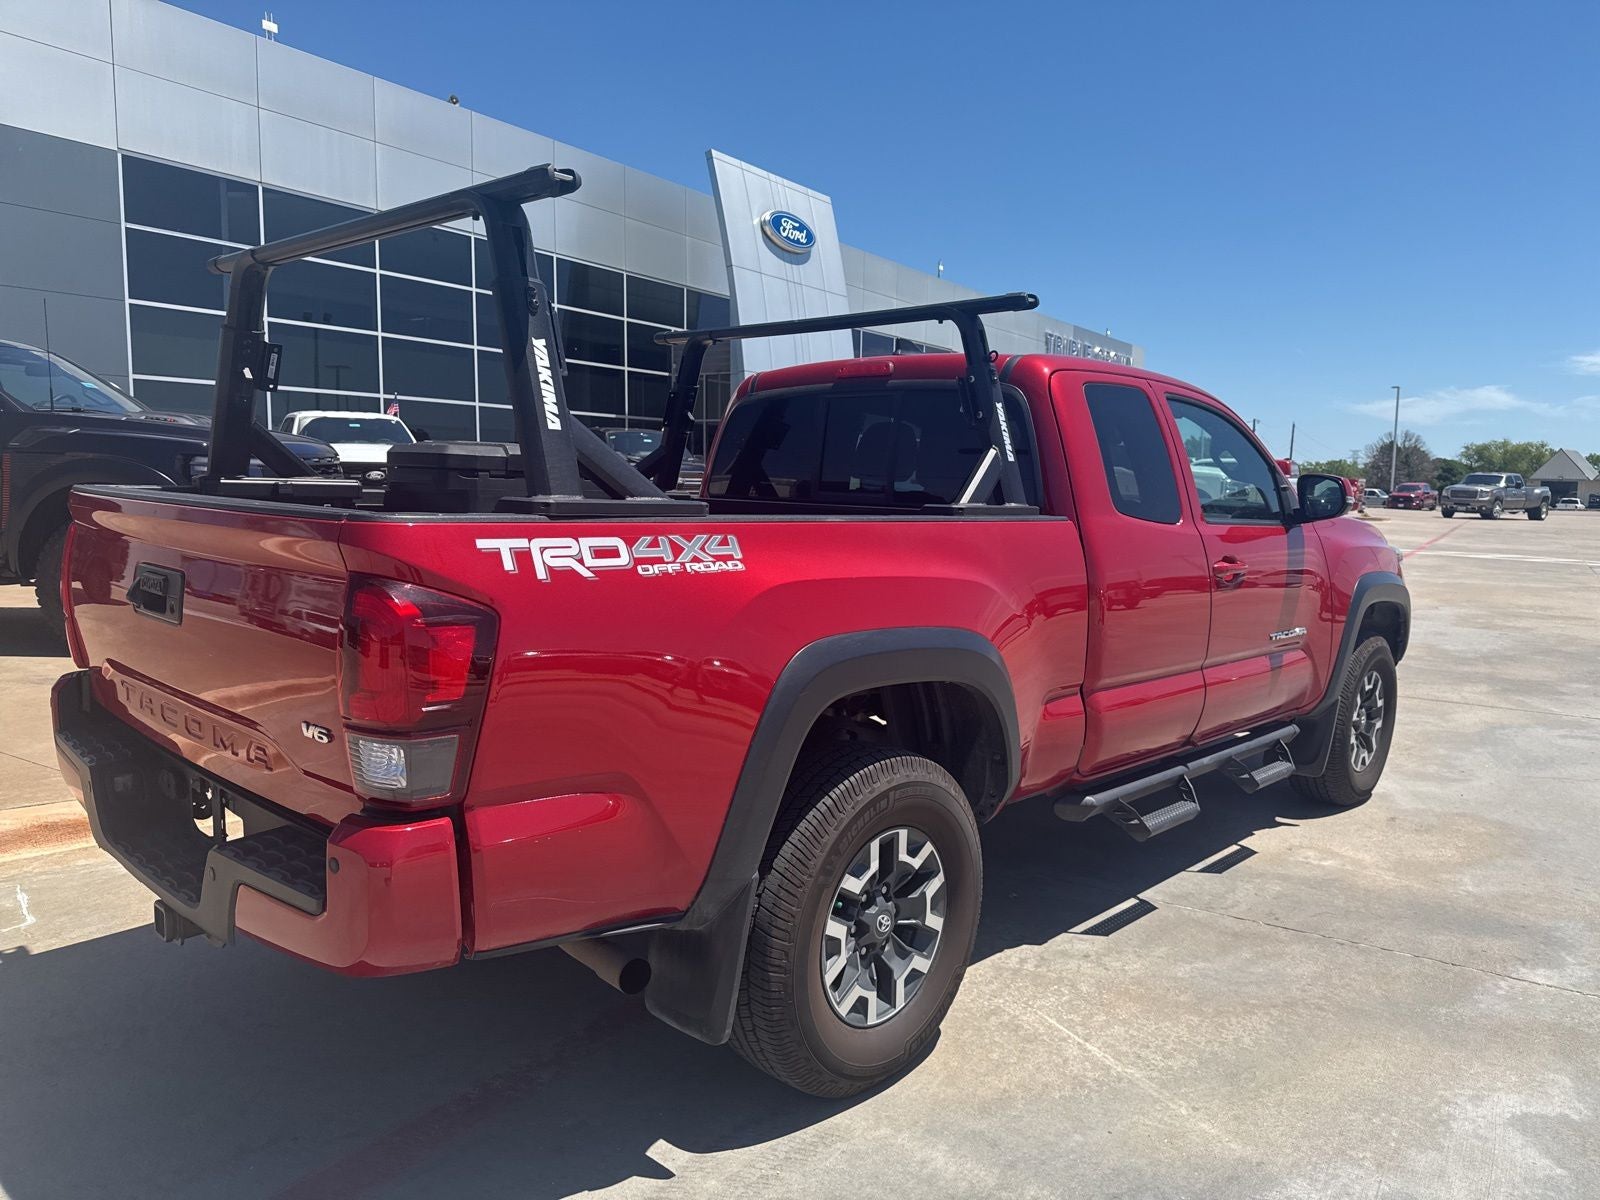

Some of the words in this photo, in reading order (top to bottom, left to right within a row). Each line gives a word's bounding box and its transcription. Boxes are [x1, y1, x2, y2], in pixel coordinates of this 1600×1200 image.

[780, 218, 807, 243] Ford
[532, 337, 562, 430] YAKIMA
[995, 402, 1015, 462] YAKIMA
[475, 537, 633, 582] TRD
[637, 562, 681, 576] OFF
[686, 560, 745, 574] ROAD
[120, 679, 274, 772] TACOMA
[301, 721, 333, 744] V6
